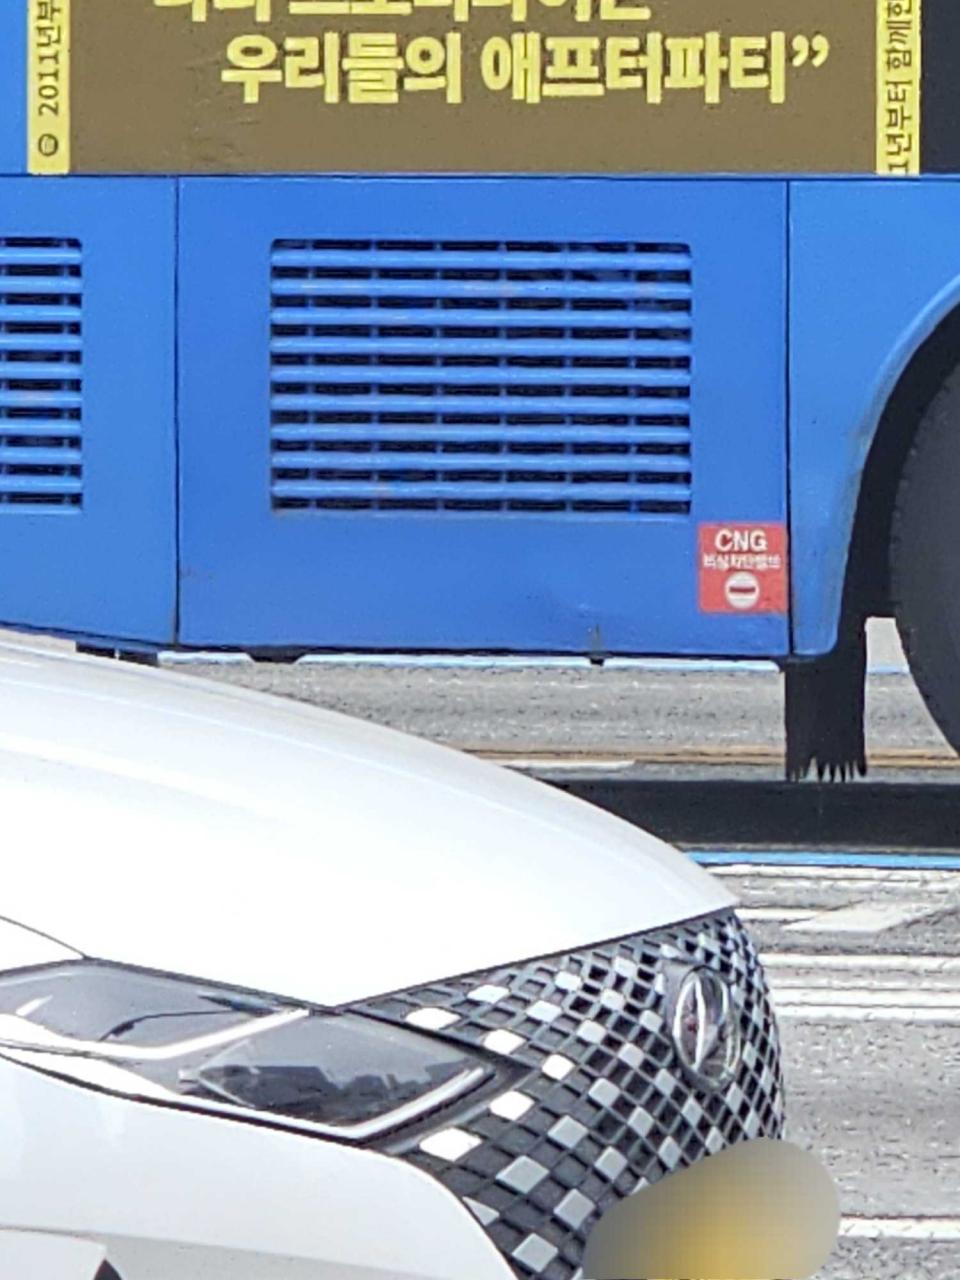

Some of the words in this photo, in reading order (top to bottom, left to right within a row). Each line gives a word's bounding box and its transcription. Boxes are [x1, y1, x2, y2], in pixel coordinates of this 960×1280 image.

[220, 31, 463, 104] 우리들의
[480, 31, 830, 104] 애프터파티”
[715, 528, 768, 552] CNG
